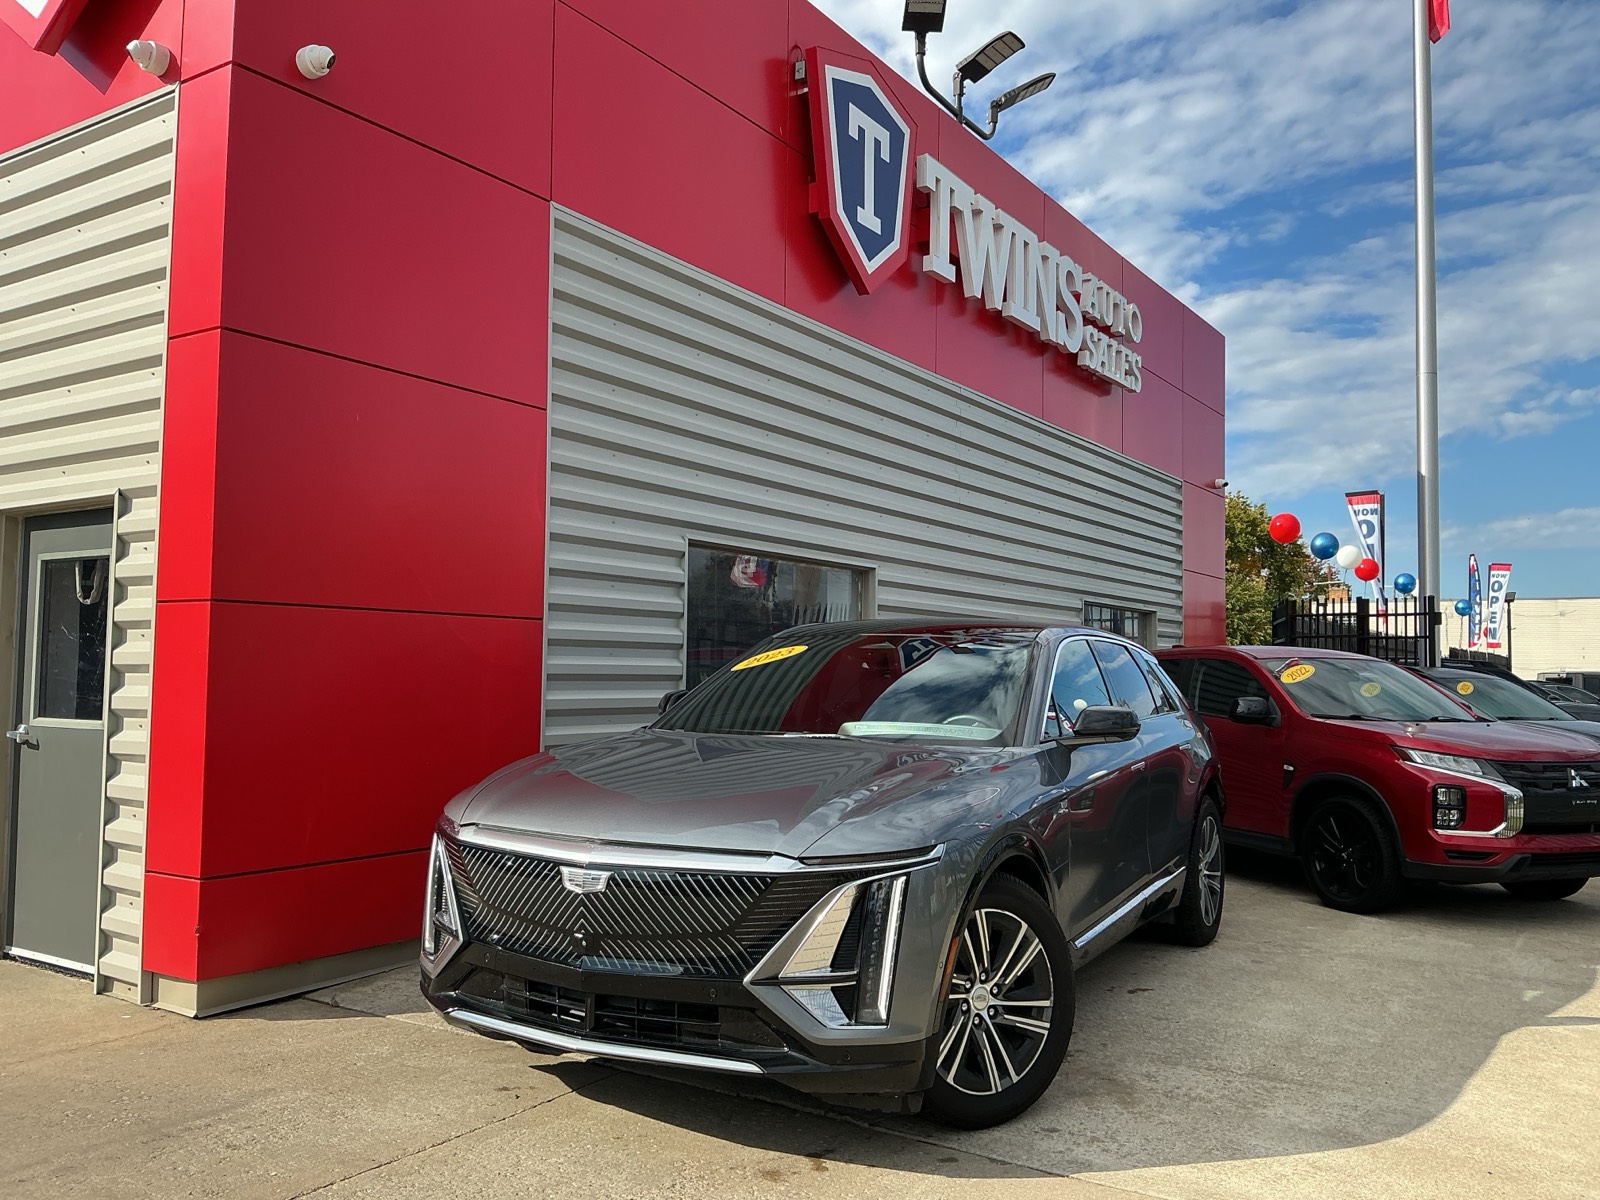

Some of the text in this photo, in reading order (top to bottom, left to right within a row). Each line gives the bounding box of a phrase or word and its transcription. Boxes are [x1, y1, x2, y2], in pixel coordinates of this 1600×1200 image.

[848, 102, 890, 235] T
[916, 153, 1083, 354] TWINS
[1081, 272, 1143, 344] AUTO
[1077, 325, 1142, 393] SALES
[1488, 580, 1504, 641] OPEN
[743, 647, 796, 668] 2023
[1286, 666, 1311, 681] 2022
